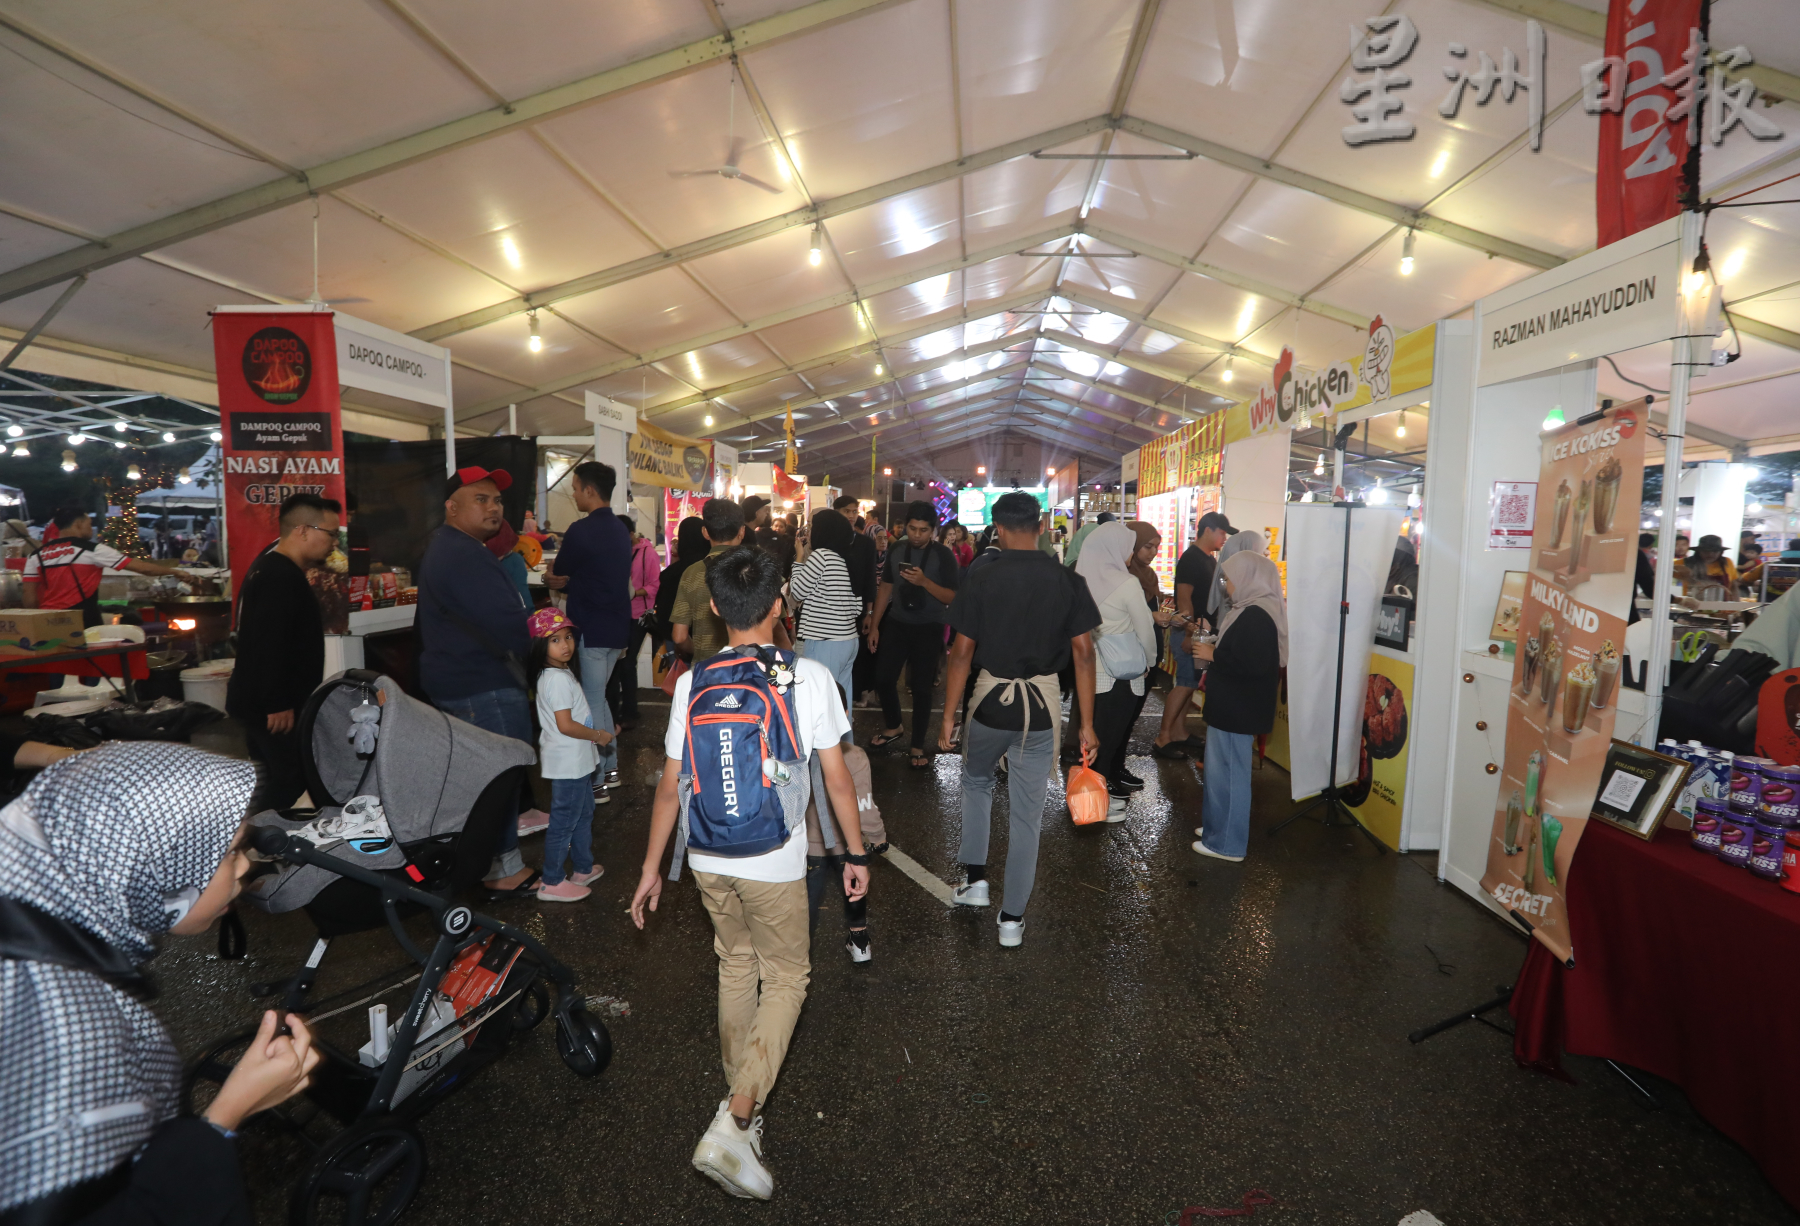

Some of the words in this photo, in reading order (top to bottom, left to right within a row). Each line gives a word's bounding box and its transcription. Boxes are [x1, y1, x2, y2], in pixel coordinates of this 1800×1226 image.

[1493, 313, 1546, 350] RAZMAN
[1549, 275, 1657, 332] MAHAYUDDIN
[253, 338, 298, 351] DAPOQ
[349, 343, 384, 368] DAPOQ
[1250, 387, 1277, 430] Why
[1276, 367, 1349, 423] Chicken
[240, 422, 283, 433] DAMPOQ
[283, 422, 322, 432] CAMPOQ
[255, 433, 280, 444] Ayam
[281, 433, 308, 444] Gepuk
[1549, 441, 1570, 463] ICE
[1570, 425, 1621, 457] KOKISS
[226, 456, 279, 474] NASI
[283, 457, 341, 474] AYAM
[1531, 579, 1565, 611] MILKY
[719, 728, 740, 818] GREGORY
[1490, 882, 1553, 917] SECRET
